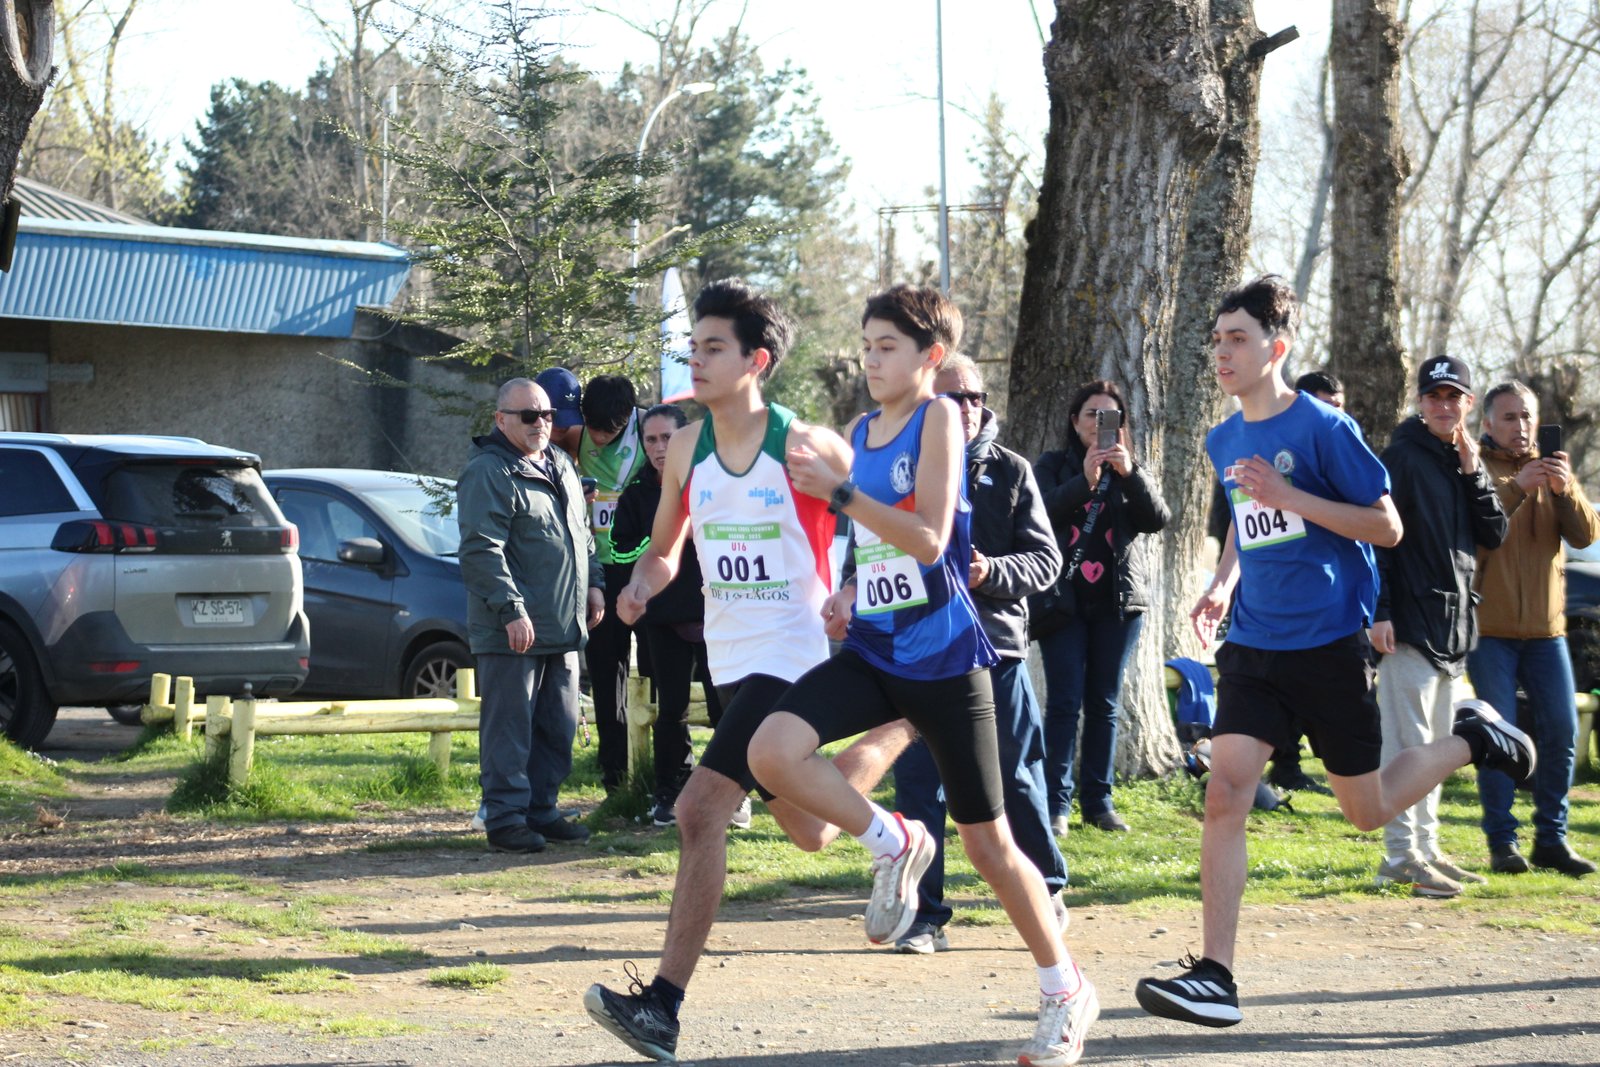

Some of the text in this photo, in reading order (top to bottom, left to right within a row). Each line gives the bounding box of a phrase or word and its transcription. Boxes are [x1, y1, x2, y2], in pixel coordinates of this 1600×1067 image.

[1245, 509, 1288, 539] 004
[731, 542, 747, 551] U16
[717, 554, 770, 581] 001
[871, 563, 886, 573] U16
[867, 573, 912, 607] 006
